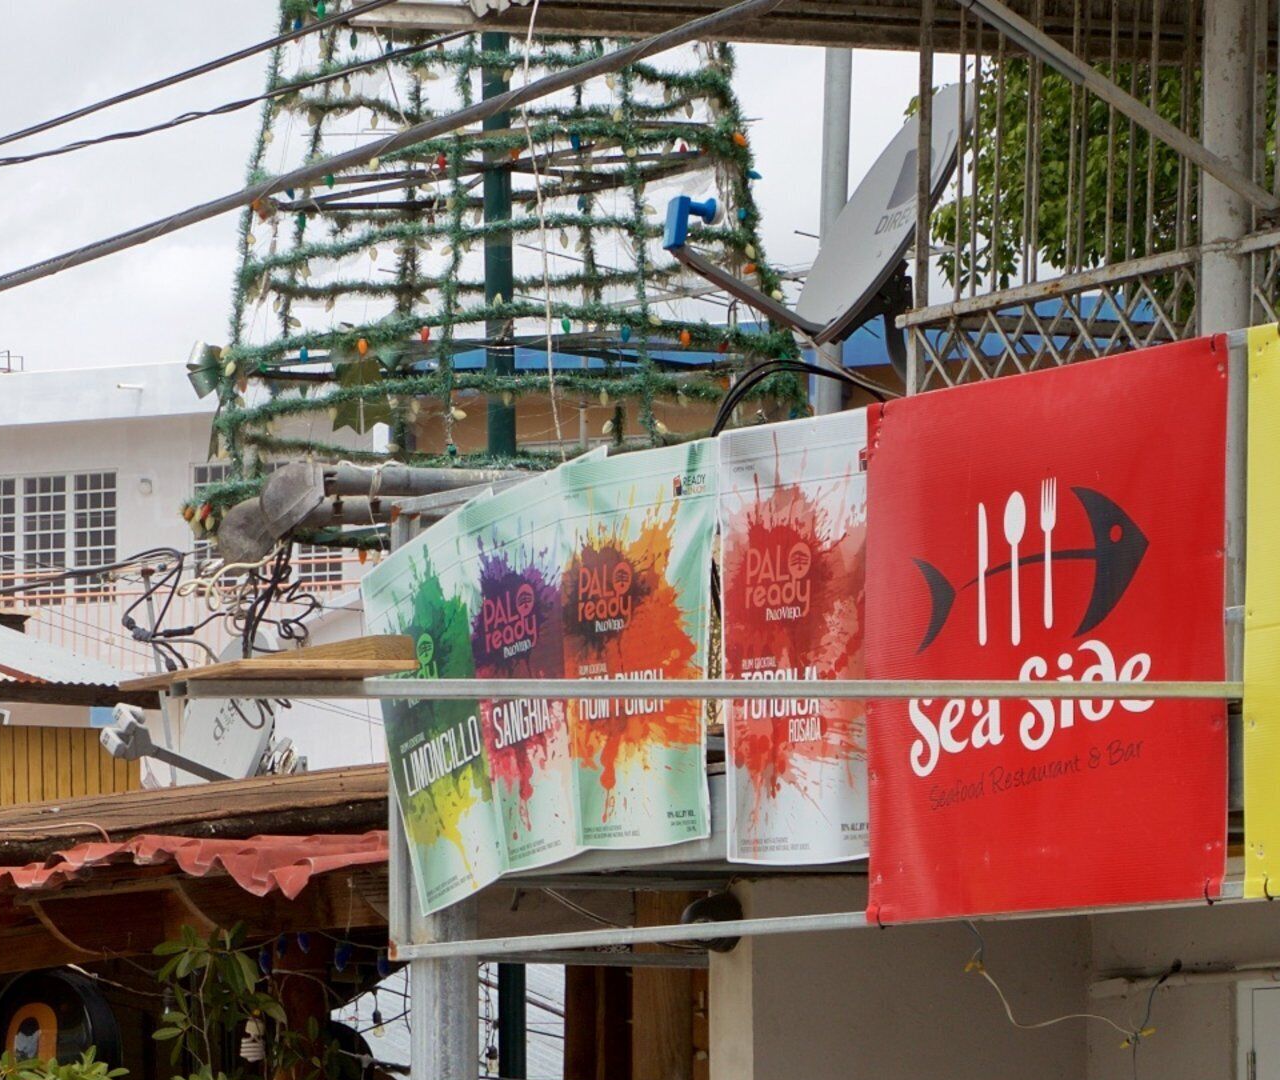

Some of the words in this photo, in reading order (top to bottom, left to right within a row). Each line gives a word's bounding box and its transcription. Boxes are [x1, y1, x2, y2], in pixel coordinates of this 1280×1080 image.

[578, 594, 632, 629] ready
[745, 578, 811, 616] ready
[485, 613, 537, 655] ready
[493, 698, 552, 748] SANGRIA
[788, 717, 822, 743] ROSADA
[908, 697, 1004, 777] Sea
[1018, 639, 1155, 750] Side
[402, 715, 481, 797] LIMONCILLO
[929, 775, 984, 811] Seafood
[989, 755, 1081, 794] Restaurant
[1087, 747, 1100, 769] &
[1107, 738, 1144, 766] Bar
